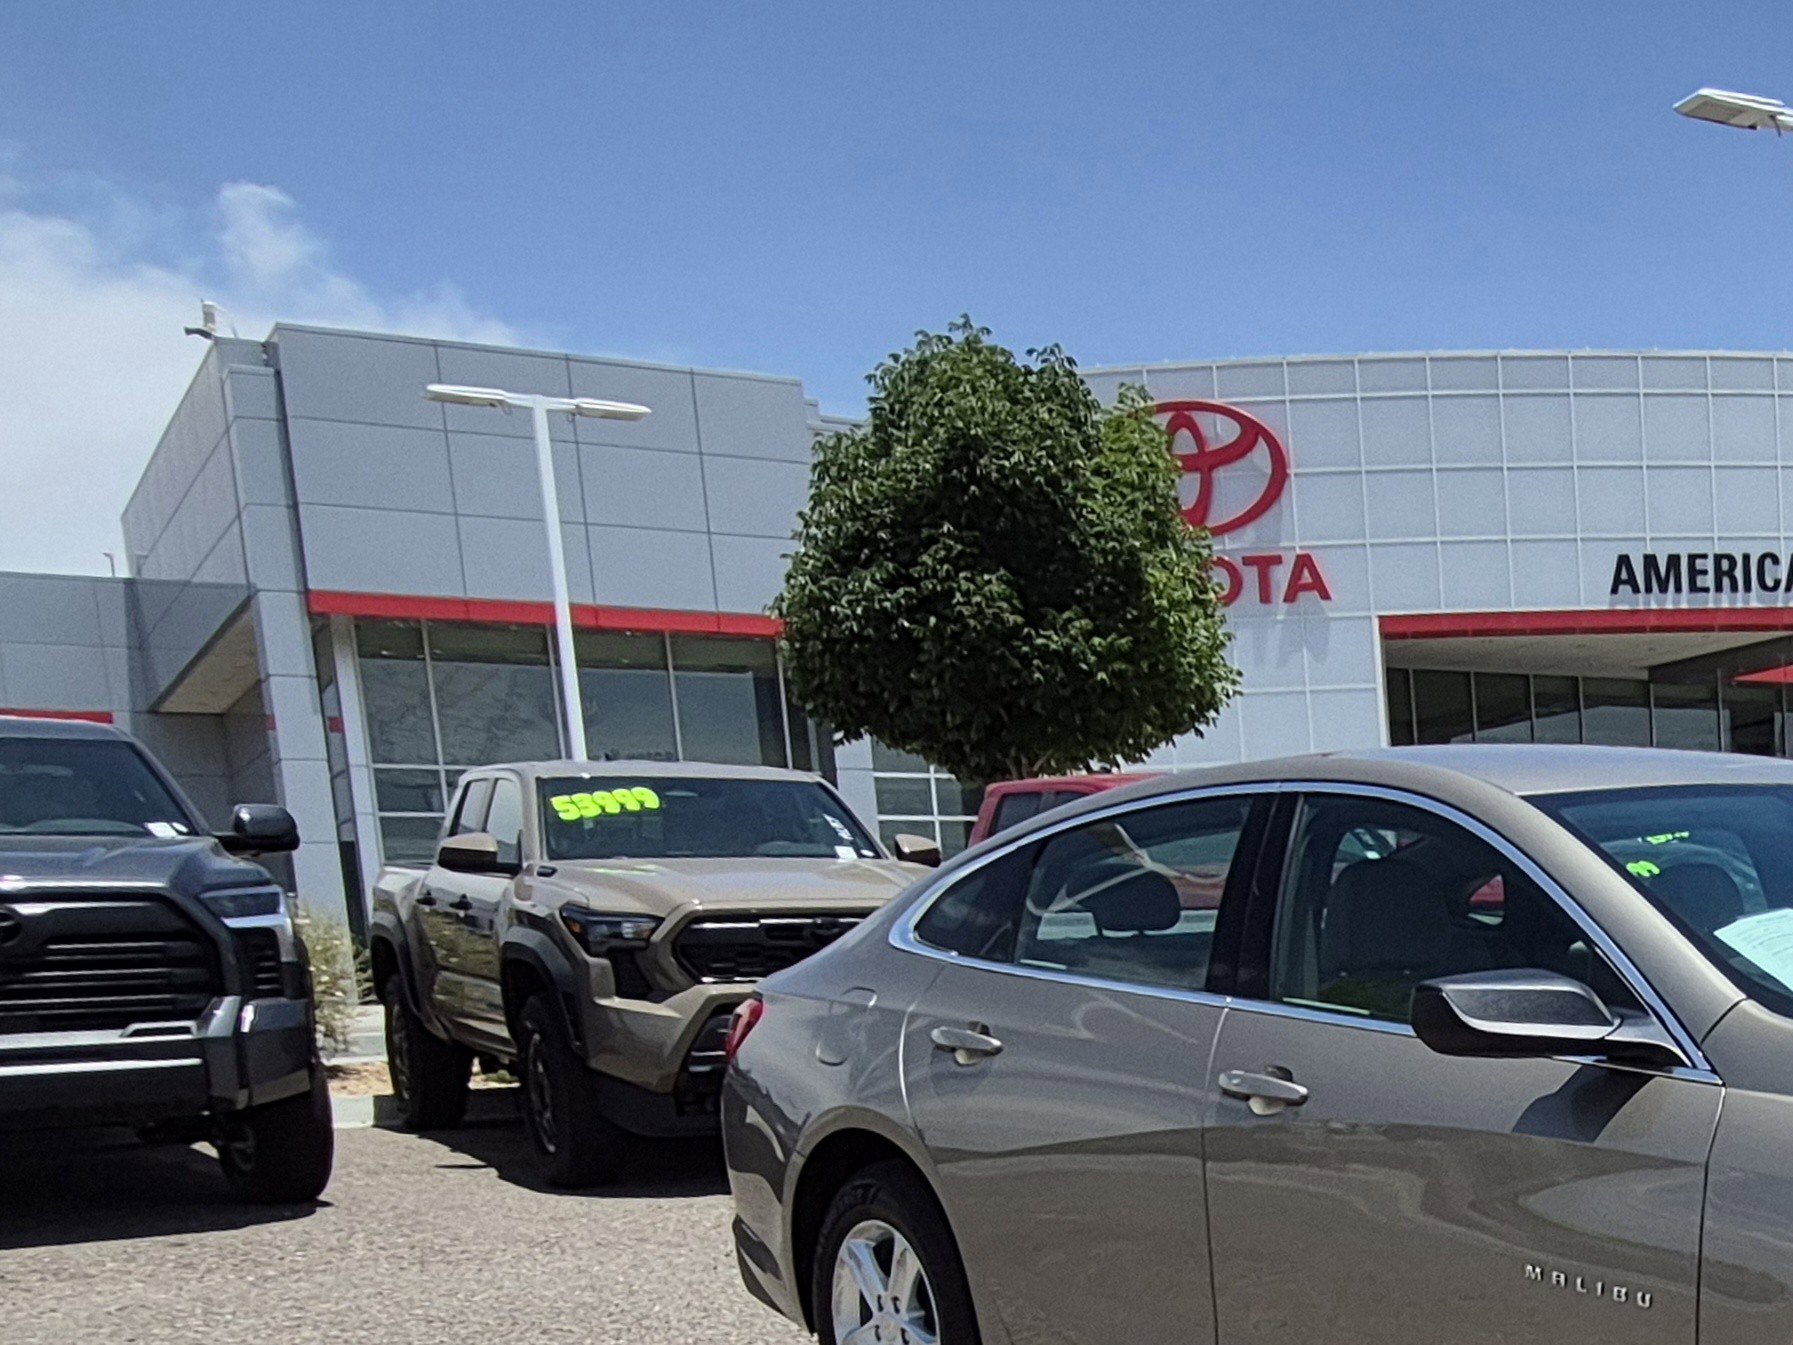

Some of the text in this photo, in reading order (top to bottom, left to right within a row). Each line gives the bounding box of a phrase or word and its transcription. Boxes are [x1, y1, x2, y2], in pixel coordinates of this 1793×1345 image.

[1202, 552, 1332, 607] OTA
[550, 786, 660, 821] 53999
[1525, 1263, 1652, 1309] MALIBU
